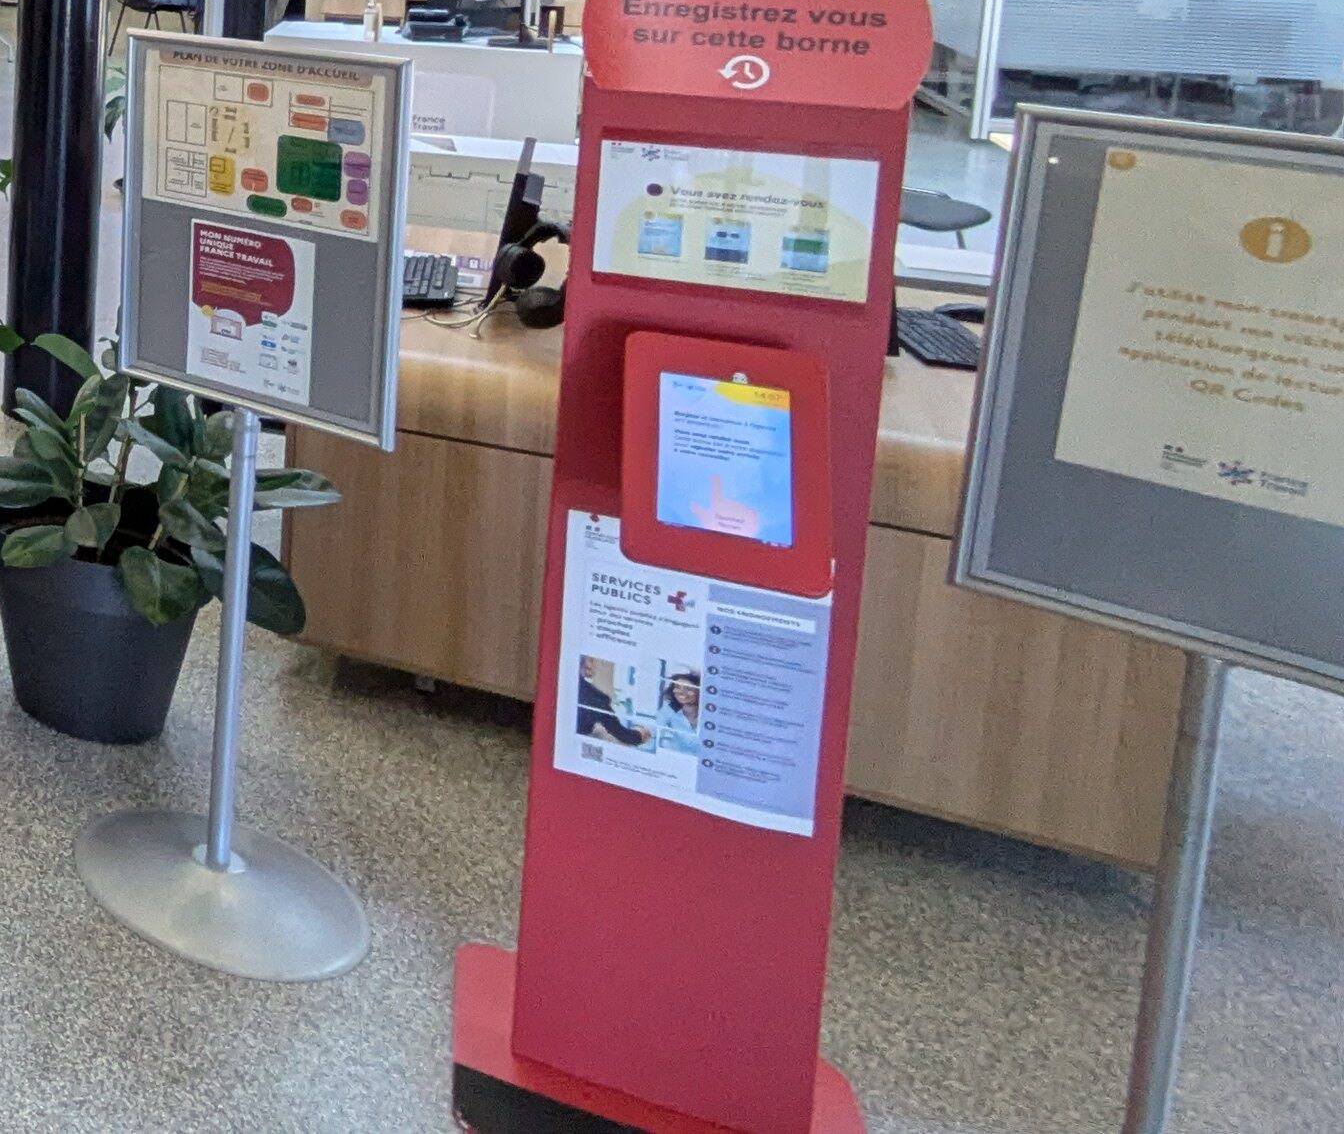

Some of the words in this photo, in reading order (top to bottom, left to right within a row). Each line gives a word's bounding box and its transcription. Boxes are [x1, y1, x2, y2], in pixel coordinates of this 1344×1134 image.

[808, 10, 888, 29] vous
[632, 27, 681, 46] sur
[691, 28, 766, 50] cette
[776, 31, 871, 57] borne
[172, 50, 202, 63] PLAN
[205, 55, 219, 65] DE
[223, 56, 259, 69] VOTRE
[261, 61, 293, 74] ZONE
[297, 66, 360, 82] D'ACCUEIL
[412, 114, 447, 124] France
[199, 237, 234, 251] UNIQUE
[200, 229, 222, 241] MON
[223, 233, 262, 249] NUMÉRO
[199, 245, 235, 259] FRANCE
[235, 252, 274, 268] TRAVAIL
[591, 584, 652, 606] PUBLICS
[592, 572, 661, 596] SERVICES
